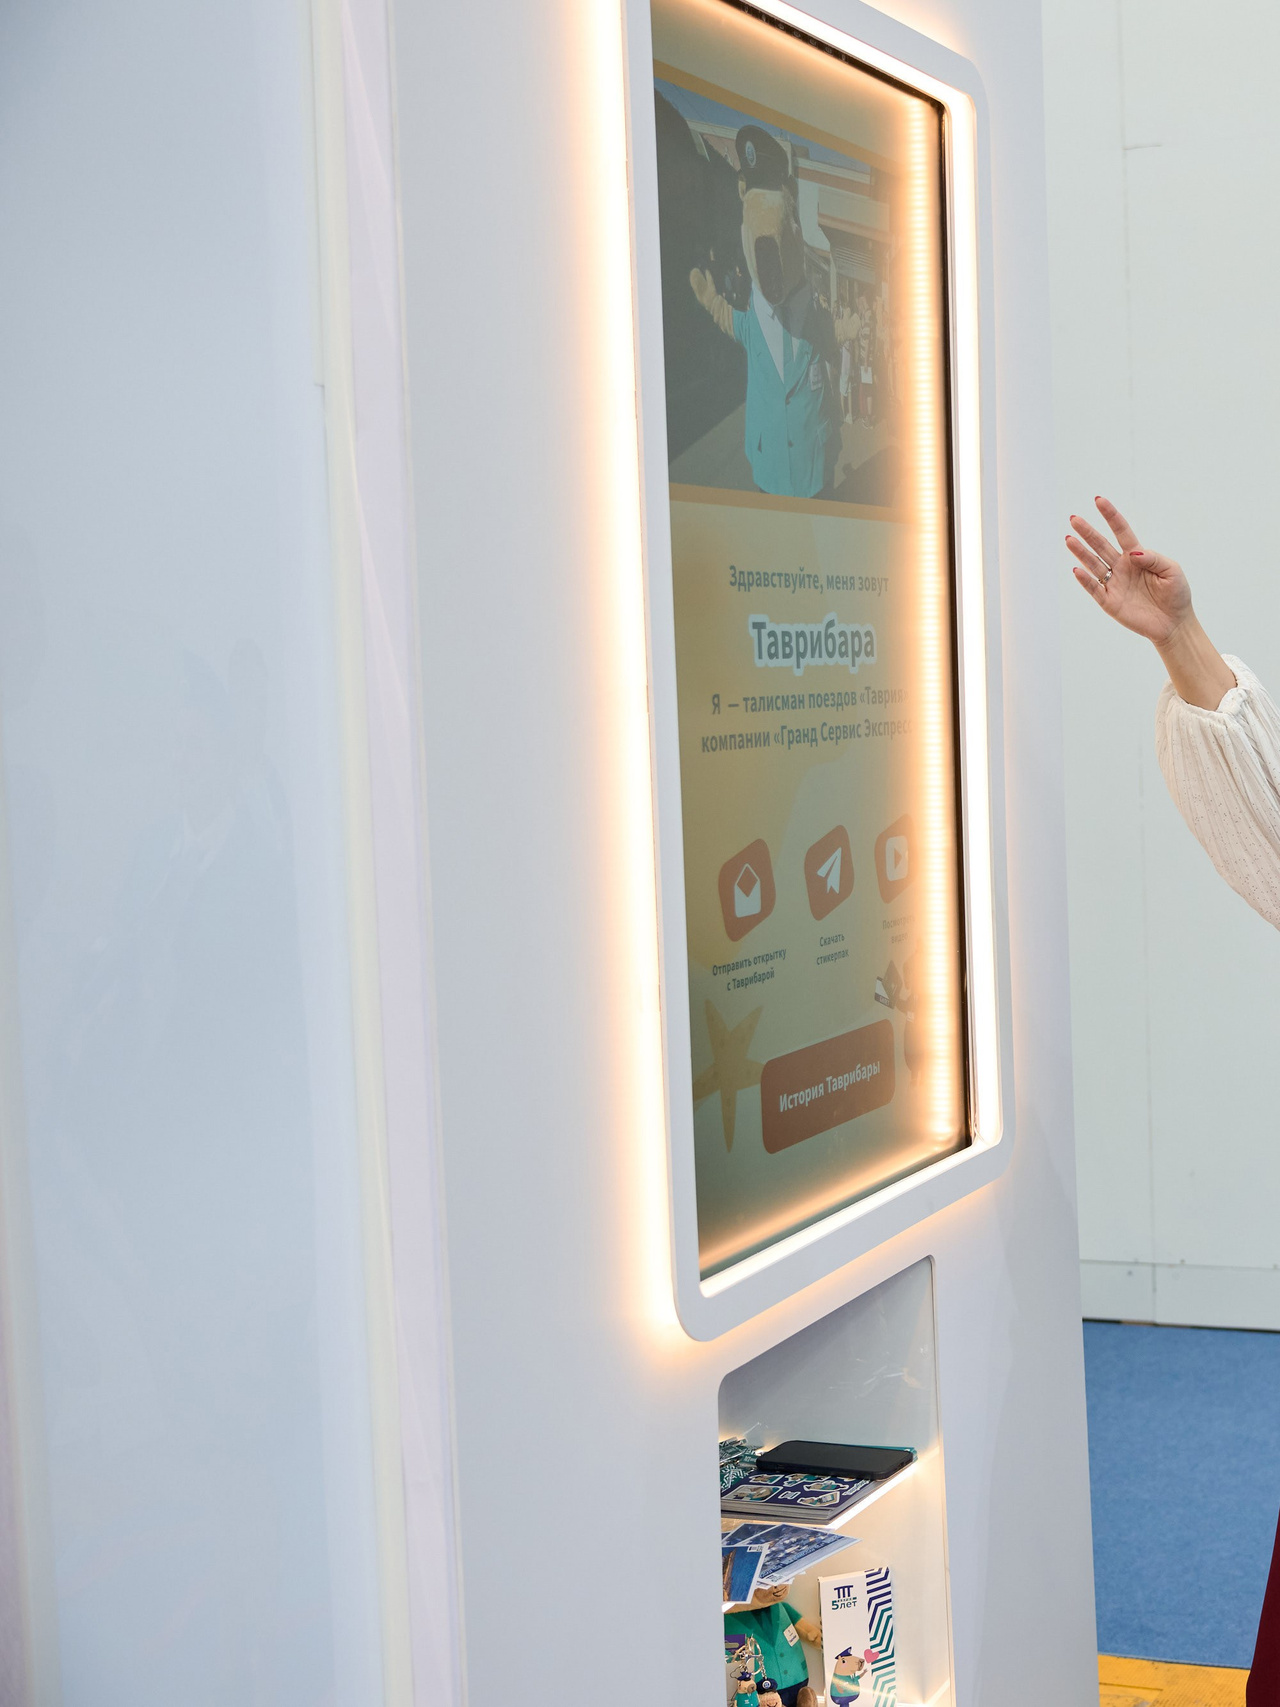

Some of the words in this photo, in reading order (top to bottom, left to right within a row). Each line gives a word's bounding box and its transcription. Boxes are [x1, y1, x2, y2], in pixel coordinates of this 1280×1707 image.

[729, 565, 823, 594] Здравствуйте,
[826, 573, 856, 591] меня
[858, 576, 889, 597] зовут
[752, 618, 875, 669] Таврибара
[711, 693, 721, 715] Я
[742, 691, 805, 713] талисман
[808, 688, 857, 711] поездов
[701, 730, 770, 753] компании
[773, 724, 818, 749] «Гранд
[820, 722, 862, 746] Сервис
[819, 932, 845, 947] Скачать
[712, 958, 752, 976] Отправить
[753, 948, 787, 966] открытку
[816, 949, 849, 966] стикерпак
[726, 983, 731, 991] с
[732, 967, 775, 990] Таврибарой
[779, 1082, 824, 1113] История
[826, 1060, 881, 1094] Таврибары
